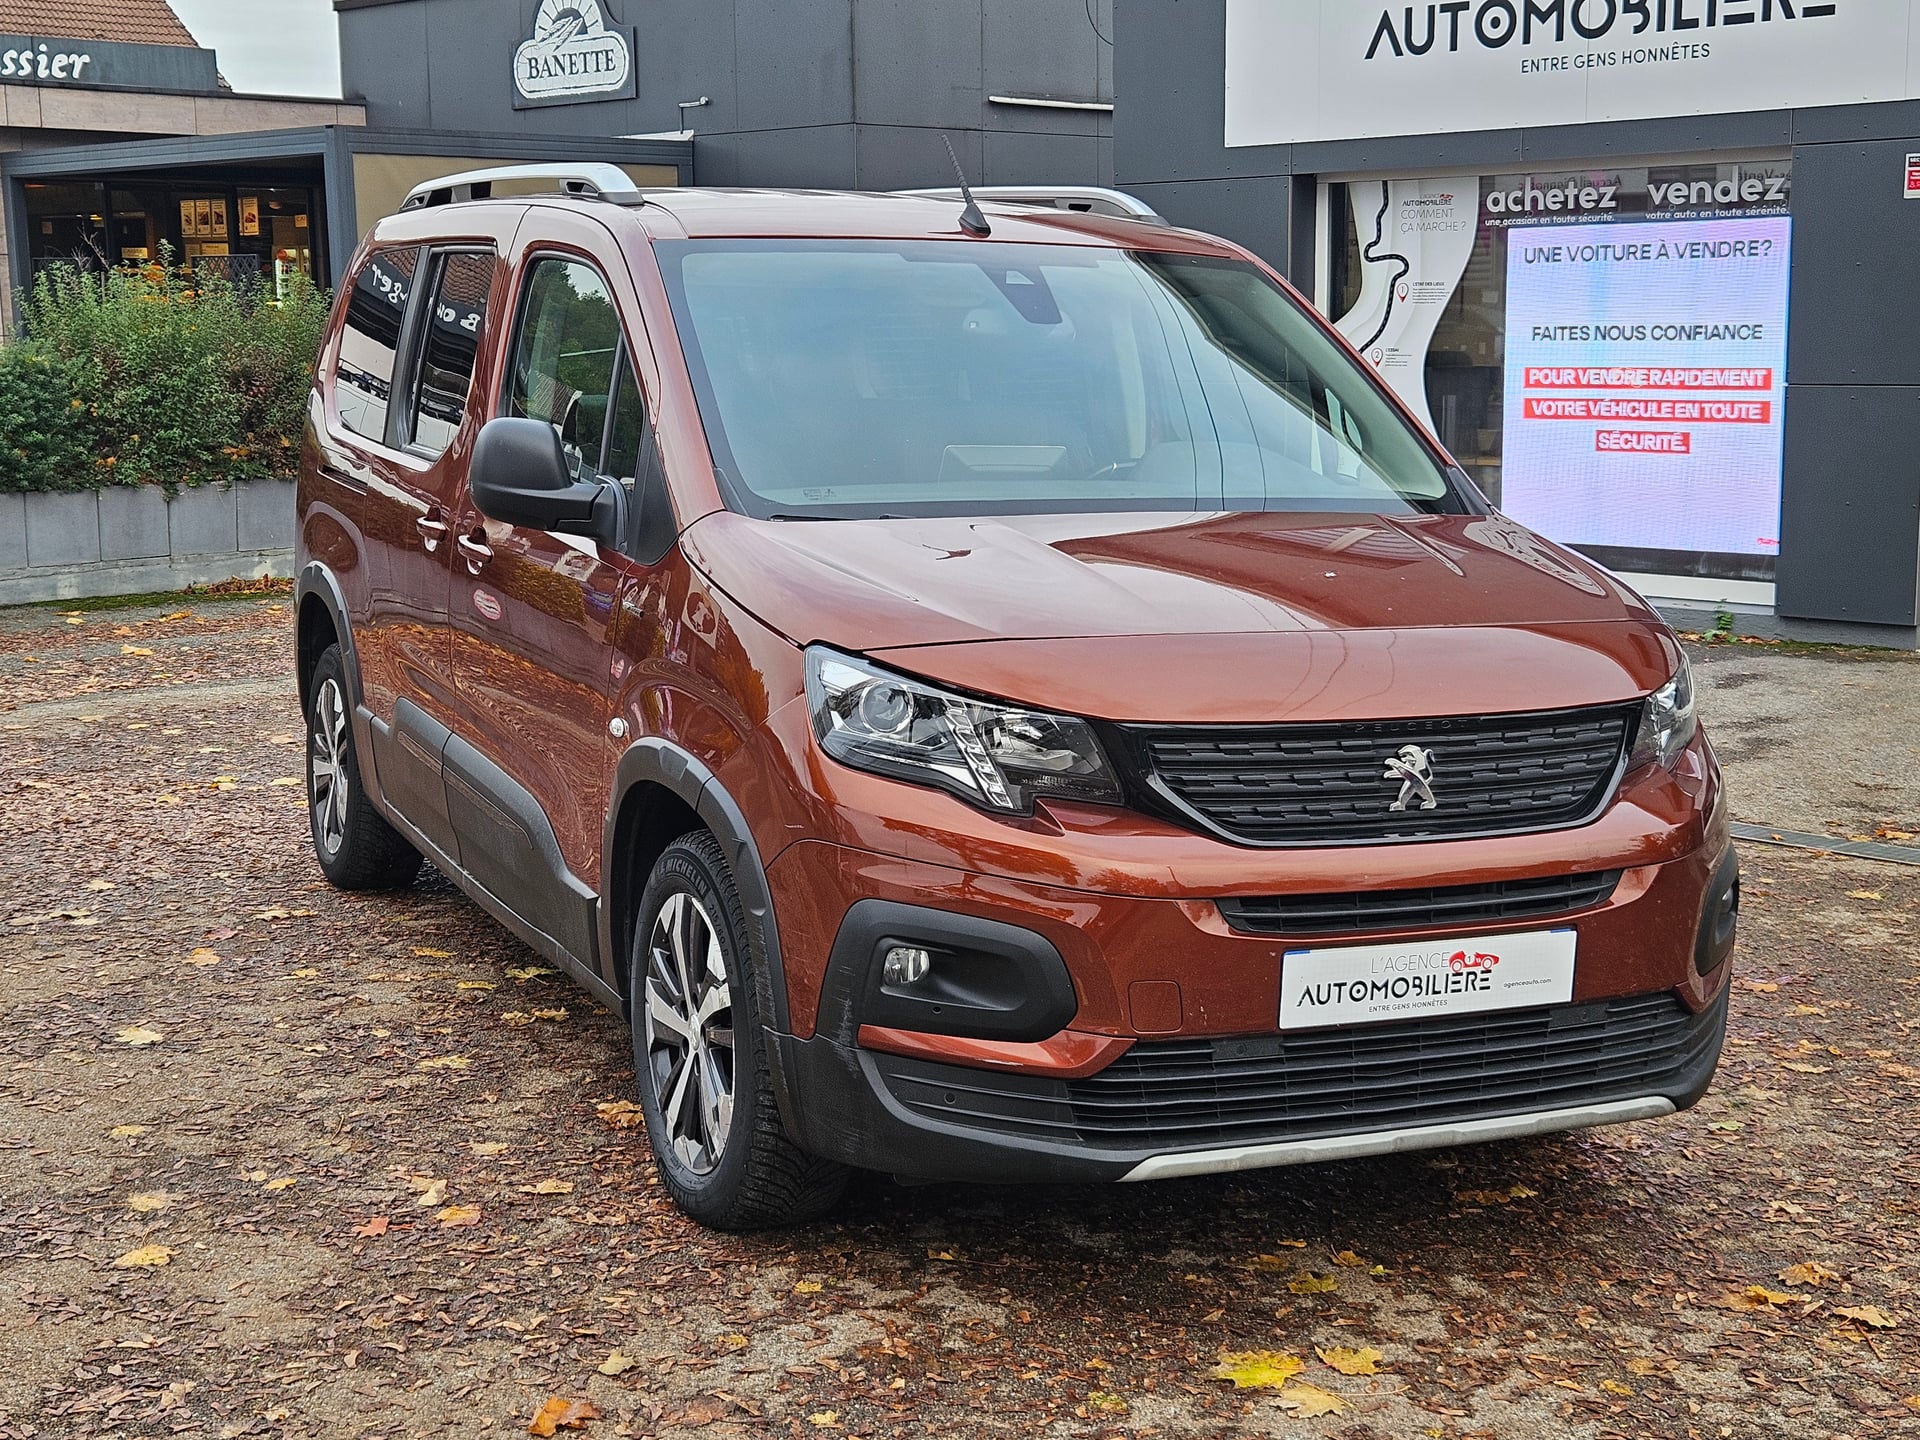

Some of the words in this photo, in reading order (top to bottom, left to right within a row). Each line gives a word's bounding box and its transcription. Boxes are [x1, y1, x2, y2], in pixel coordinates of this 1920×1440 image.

[527, 48, 616, 80] BANETTE
[1521, 56, 1569, 73] ENTRE
[1574, 51, 1617, 69] GENS
[1621, 42, 1710, 65] HONNÊTES
[1486, 176, 1617, 212] achetez
[1647, 165, 1785, 206] vendez
[1400, 208, 1454, 219] COMMENT
[1485, 219, 1501, 227] une
[1502, 215, 1538, 226] occasion
[1552, 215, 1576, 224] toute
[1645, 210, 1671, 219] votre
[1673, 210, 1697, 218] auto
[1699, 210, 1712, 218] en
[1714, 208, 1742, 217] toute
[1400, 222, 1413, 234] ÇA
[1416, 221, 1458, 232] MARCHE
[1524, 246, 1562, 264] UNE
[1567, 244, 1651, 262] VOITURE
[1655, 239, 1670, 260] À
[1674, 239, 1773, 260] VENDRE?
[1532, 326, 1590, 341] FAITES
[1594, 325, 1646, 341] NOUS
[1651, 324, 1763, 341] CONFIANCE
[1528, 368, 1576, 385] POUR
[1577, 368, 1649, 387] VENDRE
[1650, 368, 1768, 387] RAPIDEMENT
[1531, 400, 1587, 416] VOTRE
[1588, 399, 1673, 418] VÉHICULE
[1674, 402, 1700, 418] EN
[1701, 403, 1763, 419] TOUTE
[665, 858, 708, 895] MICHELIN
[1371, 951, 1450, 974] L'AGENCE
[1296, 969, 1492, 1007] AUTOMOBILIERE
[1503, 978, 1552, 988] agenceauto.com
[1368, 1004, 1390, 1013] ENTRE
[1391, 1002, 1410, 1010] GENS
[1411, 999, 1448, 1009] HONNÊTES
